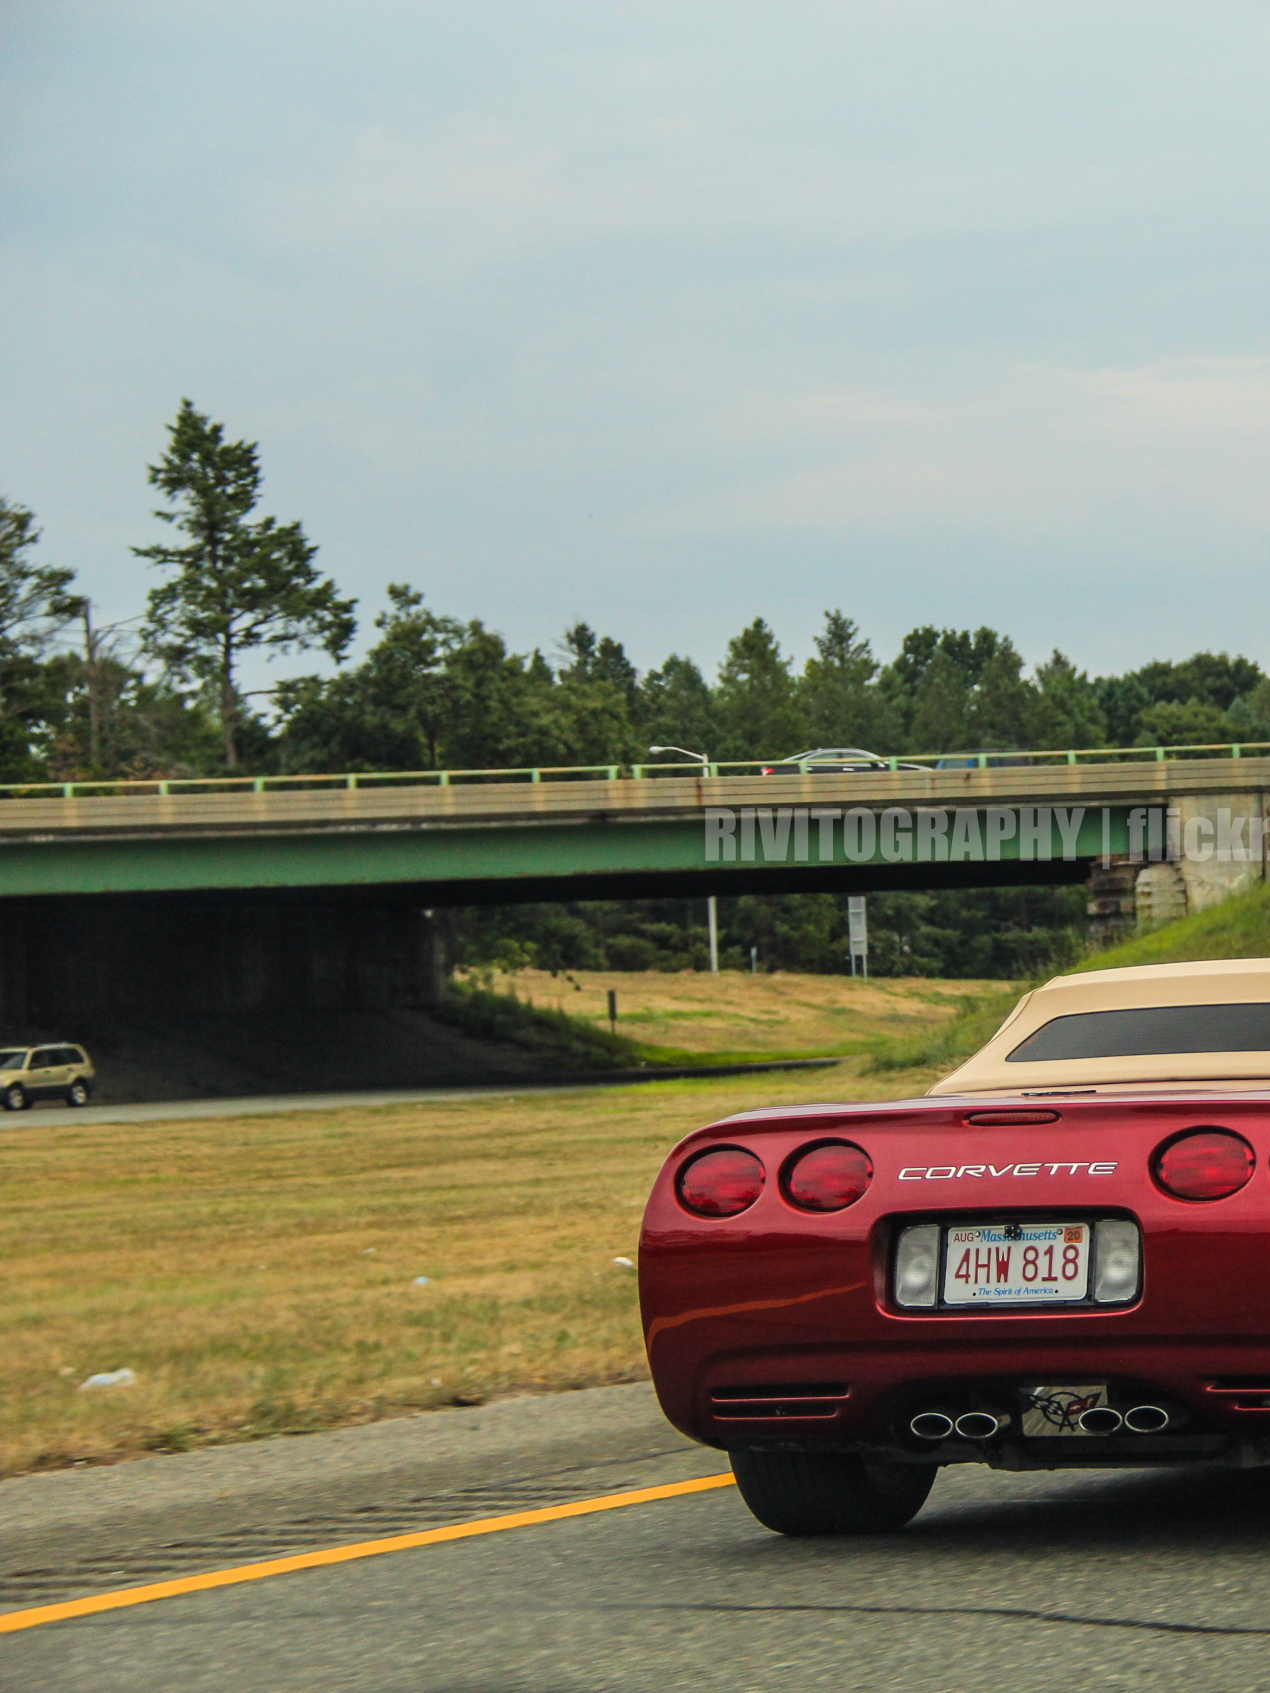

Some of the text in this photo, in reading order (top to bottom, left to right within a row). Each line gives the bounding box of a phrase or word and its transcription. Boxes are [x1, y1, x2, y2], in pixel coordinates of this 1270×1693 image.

[897, 1161, 1119, 1181] CORVETTE
[953, 1232, 974, 1243] AUG
[1067, 1230, 1081, 1241] 20
[954, 1244, 1080, 1284] 4HW 818
[978, 1287, 1053, 1297] The Spirit of America
